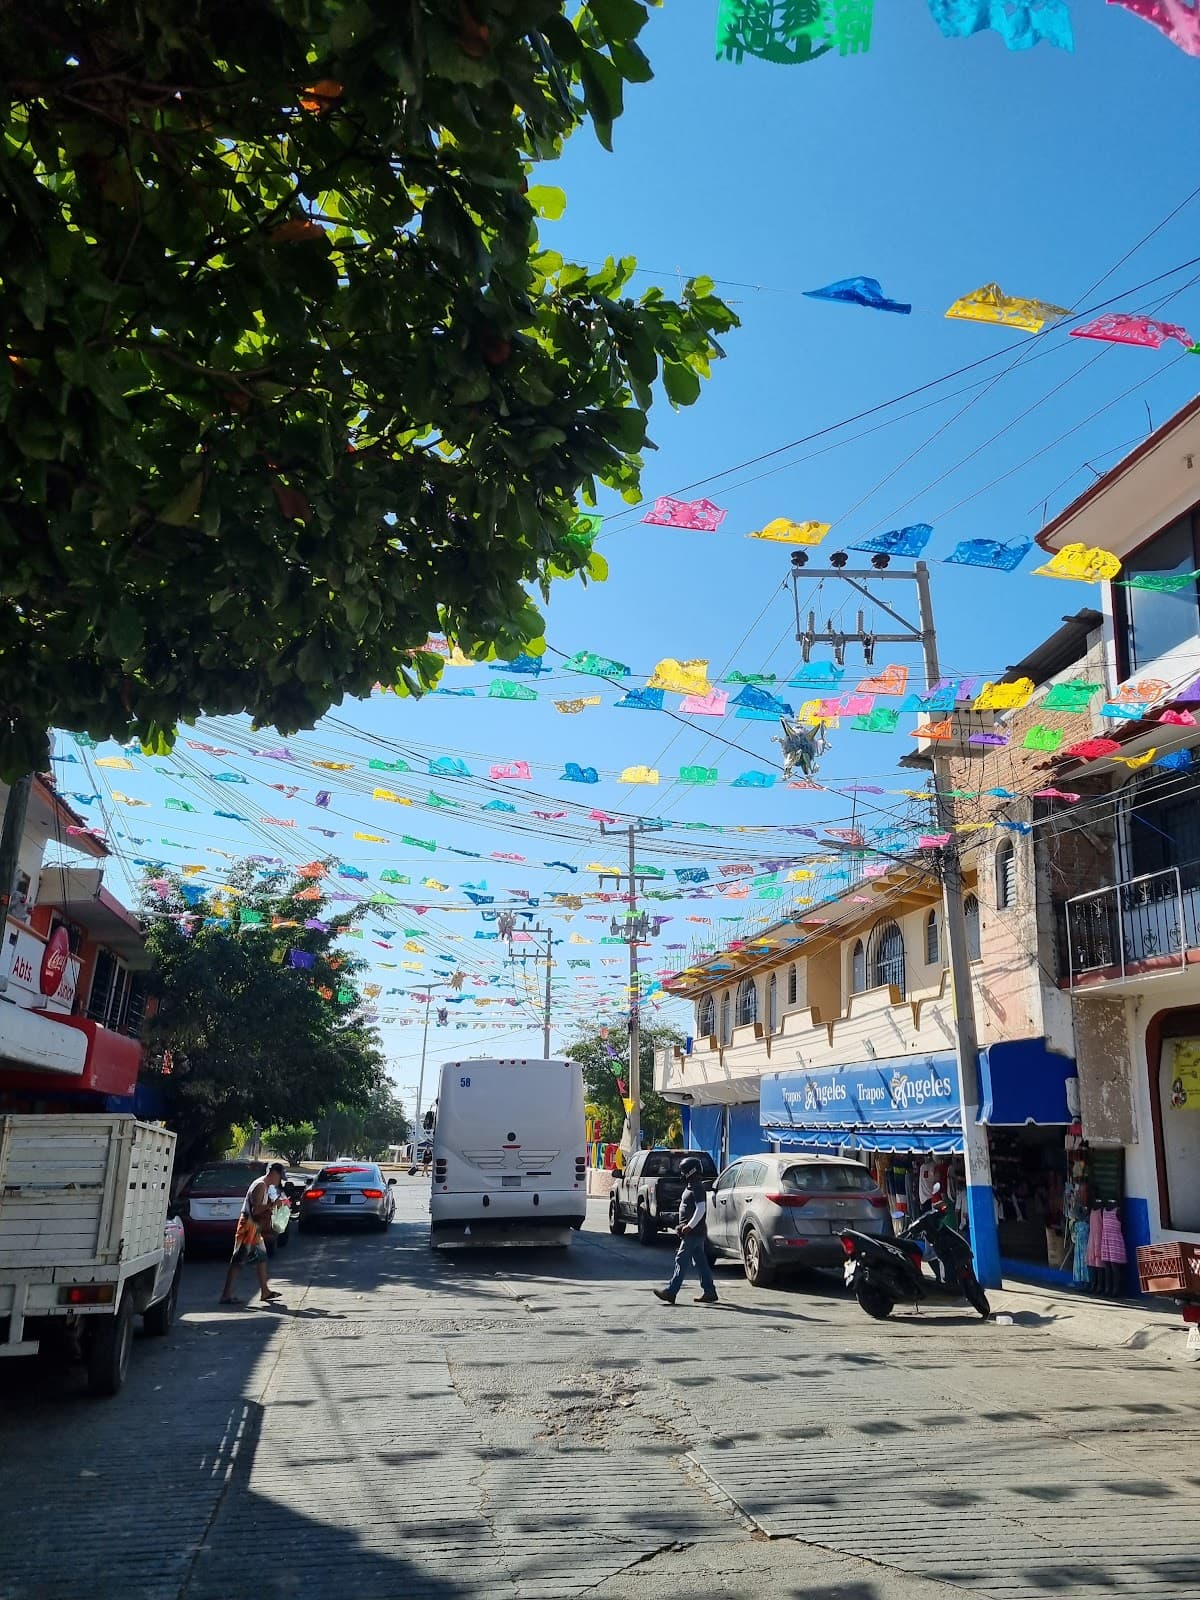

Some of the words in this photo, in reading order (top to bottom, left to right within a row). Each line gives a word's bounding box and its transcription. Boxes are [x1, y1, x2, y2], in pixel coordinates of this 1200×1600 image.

[12, 956, 33, 983] Abts.
[460, 1077, 471, 1088] 58
[856, 1083, 885, 1105] Trapos
[889, 1070, 952, 1109] Angeles
[781, 1087, 802, 1106] Trapos
